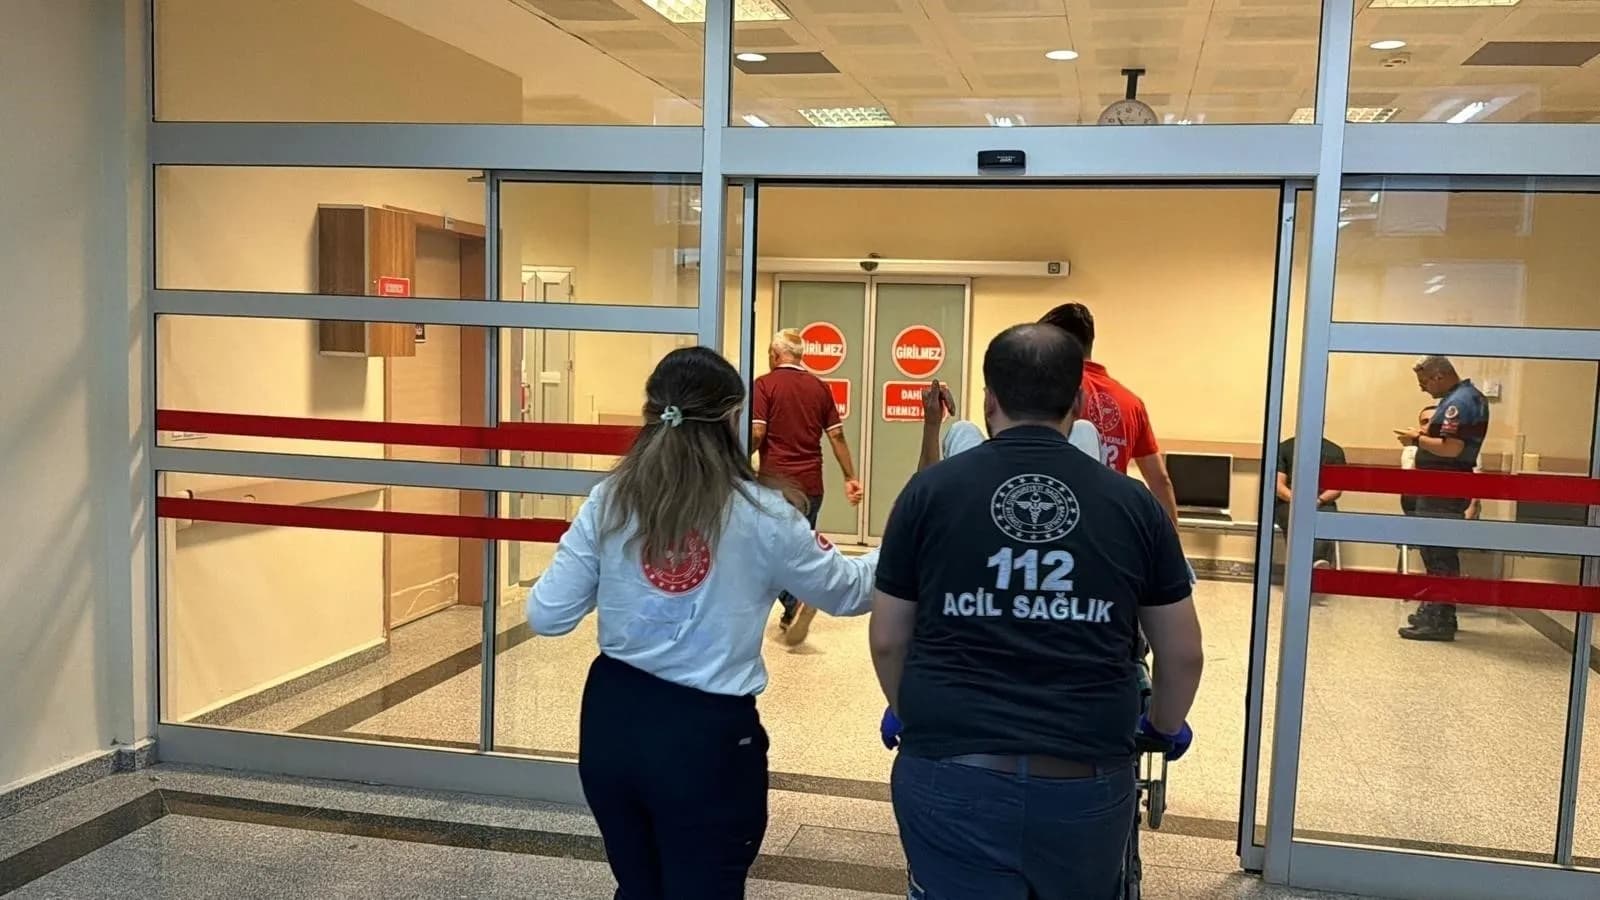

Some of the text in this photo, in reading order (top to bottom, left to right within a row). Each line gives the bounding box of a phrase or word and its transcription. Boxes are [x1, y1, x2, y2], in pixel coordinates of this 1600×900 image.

[803, 340, 843, 356] İRİLMEZ
[896, 343, 942, 360] GİRİLMEZ
[887, 405, 920, 417] KIRMIZI
[986, 547, 1075, 591] 112
[942, 587, 1115, 623] ACİL SAĞLIK
